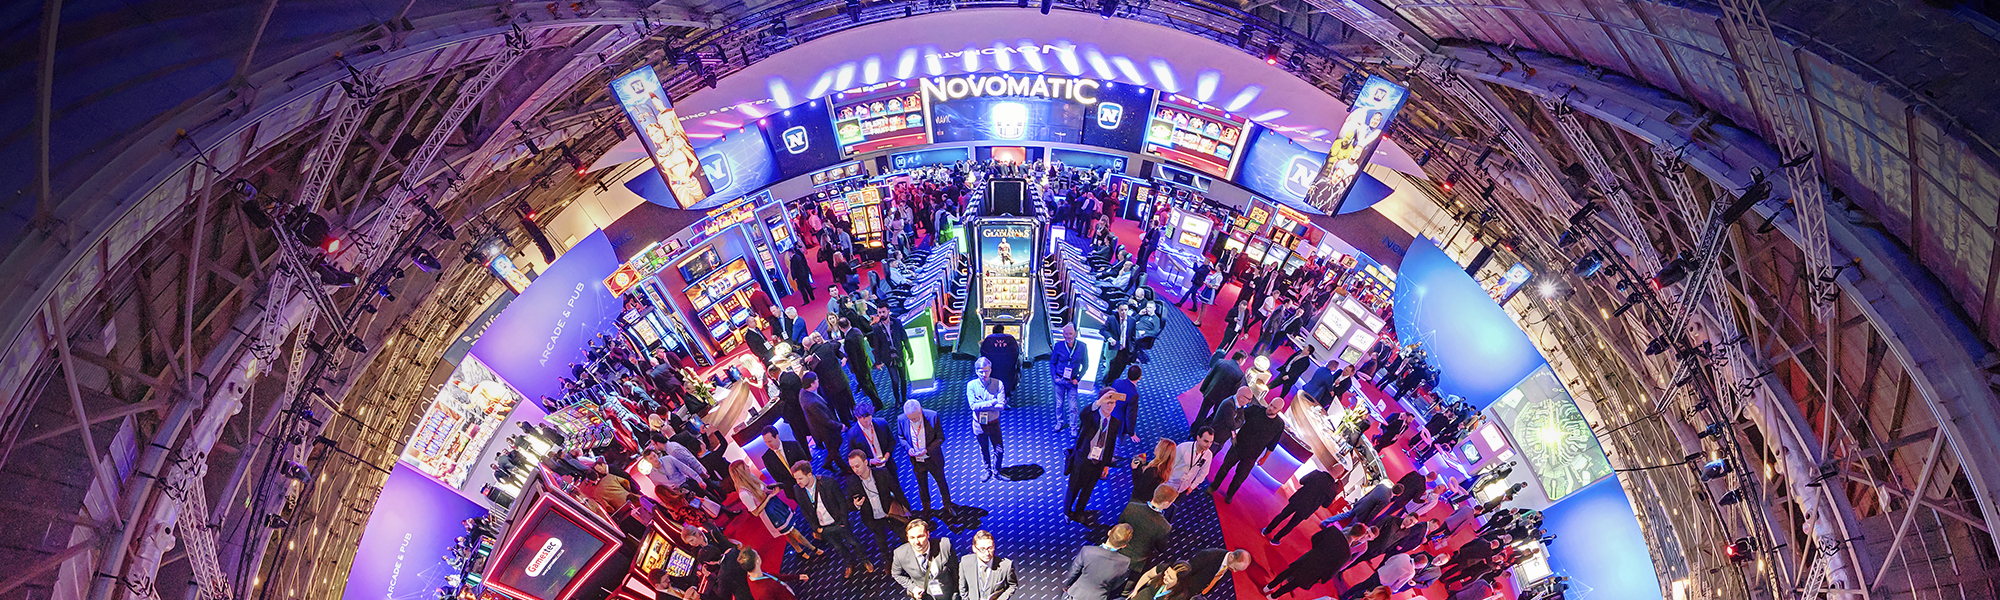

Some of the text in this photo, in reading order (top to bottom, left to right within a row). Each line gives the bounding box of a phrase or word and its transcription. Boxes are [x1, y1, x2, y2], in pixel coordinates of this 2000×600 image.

[919, 75, 1100, 105] NOVOMATIC
[679, 112, 707, 121] SINO
[539, 282, 585, 367] ARCADE & PUB
[386, 562, 402, 599] ARCADE
[400, 533, 412, 553] PUB
[528, 541, 557, 573] Gamestec
